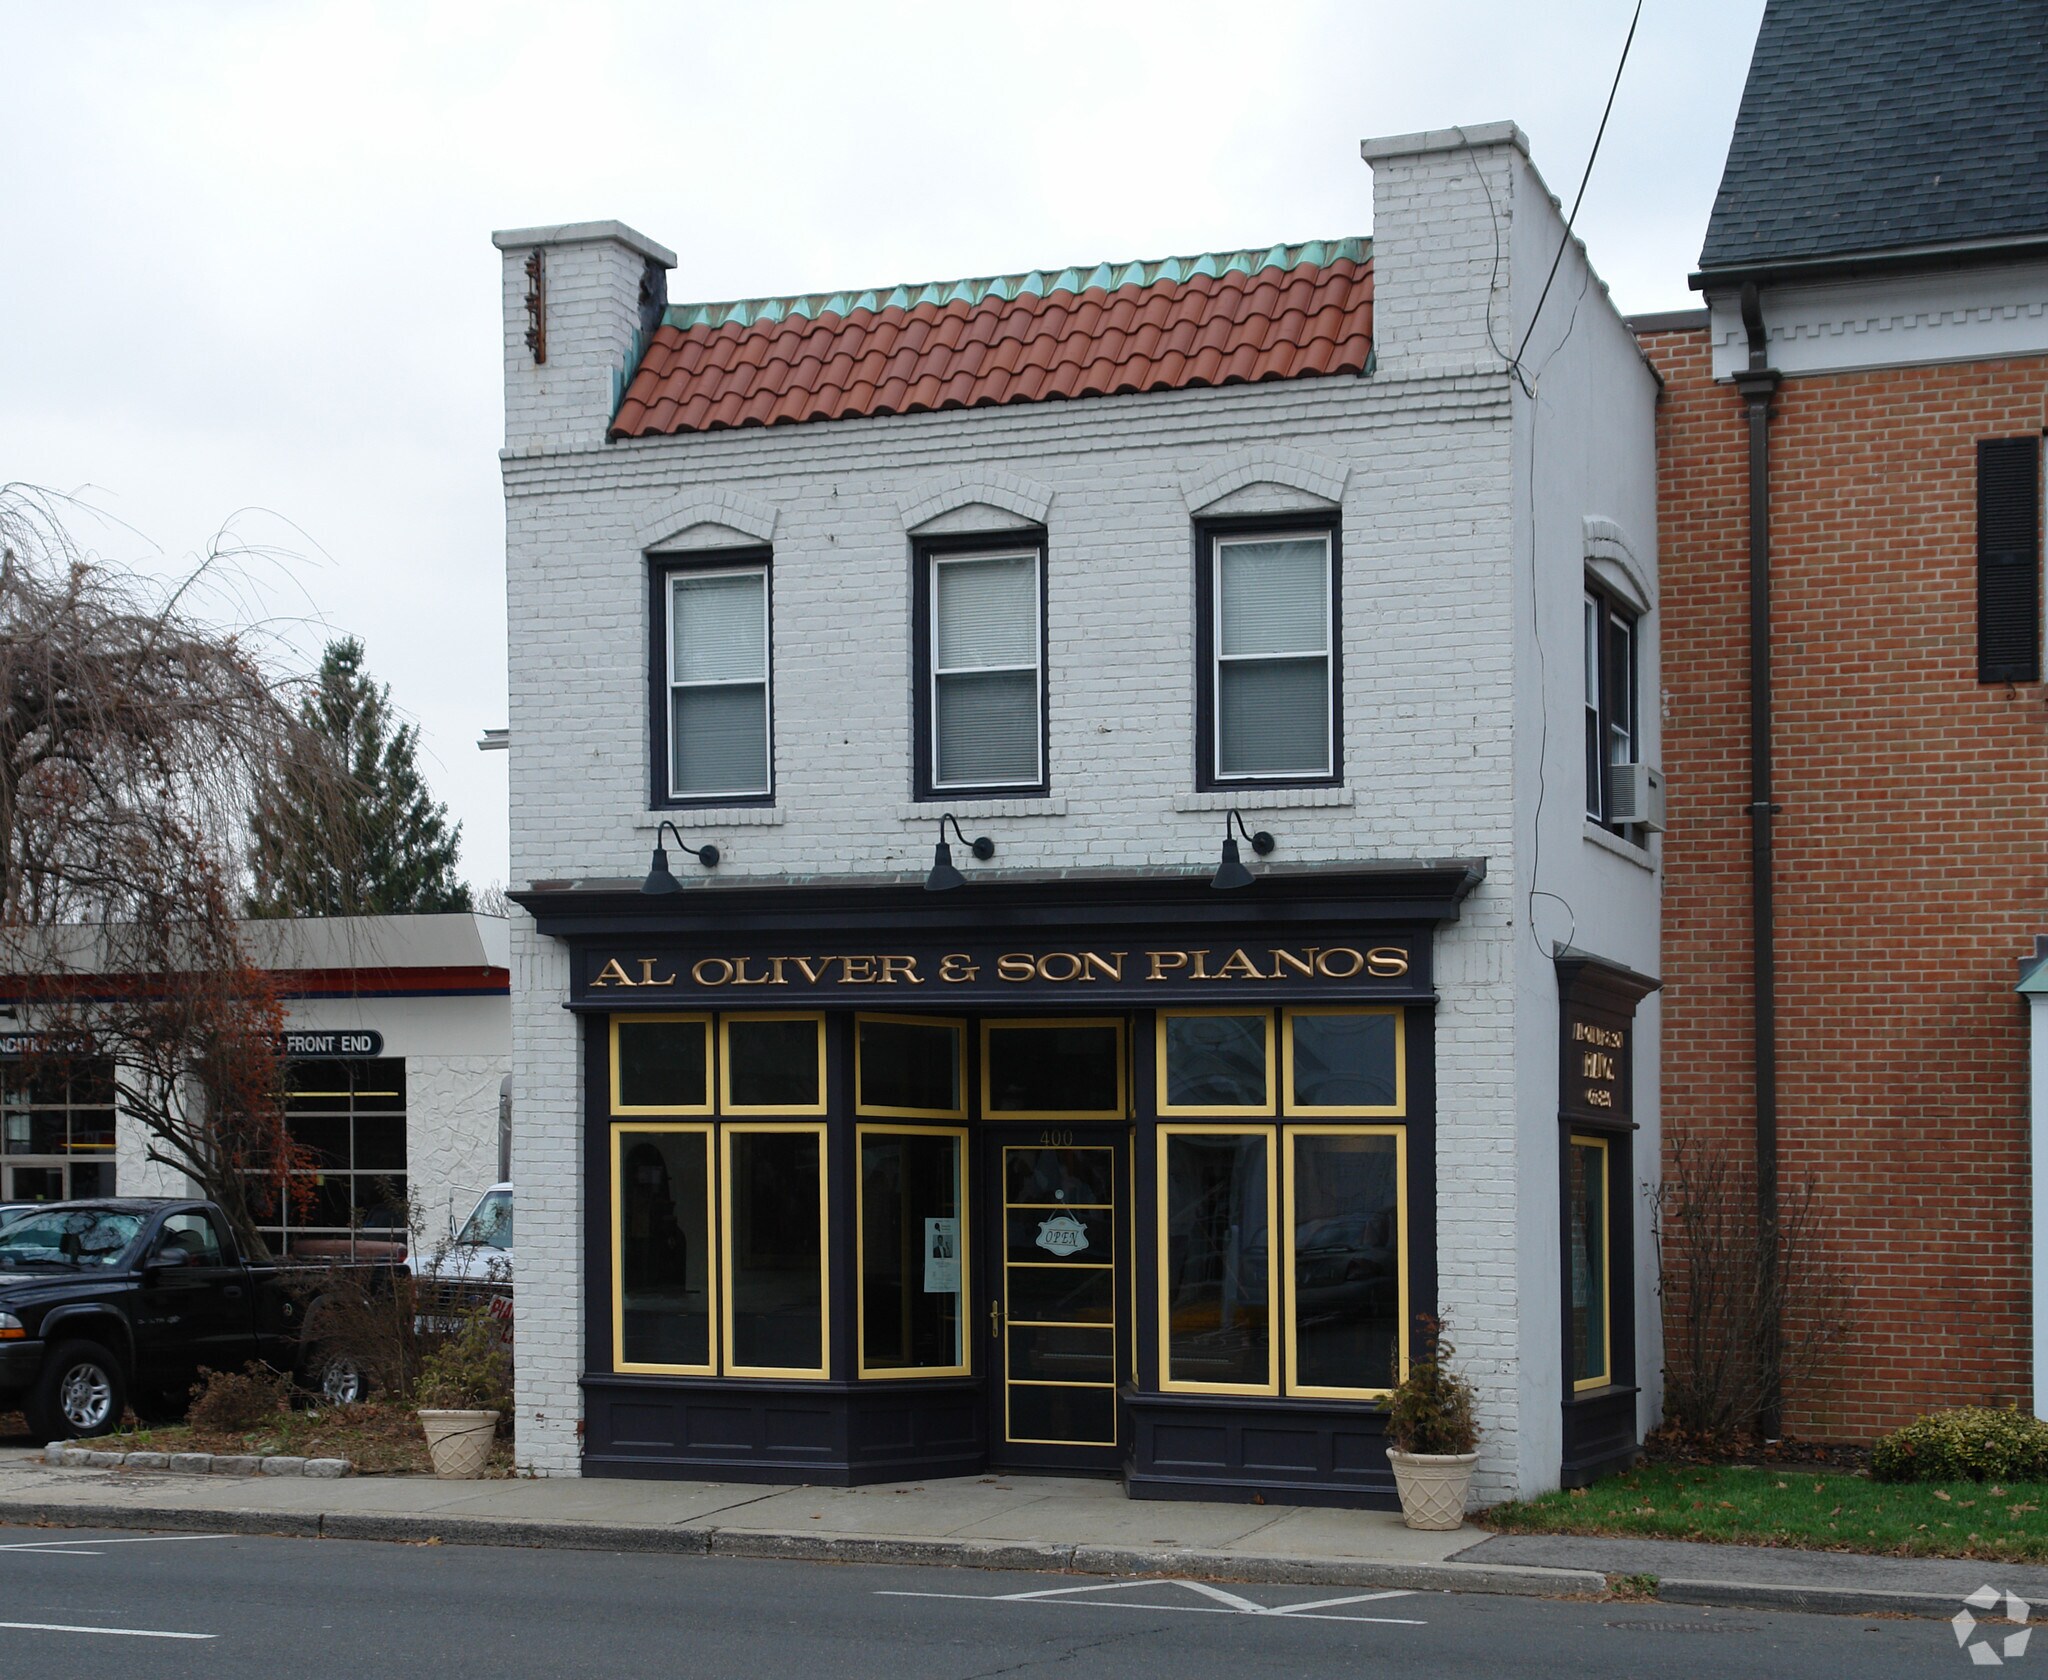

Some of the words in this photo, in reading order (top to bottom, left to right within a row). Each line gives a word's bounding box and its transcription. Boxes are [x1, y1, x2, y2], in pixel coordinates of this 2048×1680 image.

[589, 957, 677, 987] AL
[691, 954, 926, 986] OLIVER
[938, 953, 981, 984] &
[996, 951, 1129, 983] SON
[1144, 946, 1409, 980] PIANOS
[286, 1035, 335, 1052] FRONT
[341, 1035, 372, 1051] END
[1040, 1129, 1073, 1147] 400
[1045, 1230, 1079, 1247] OPEN
